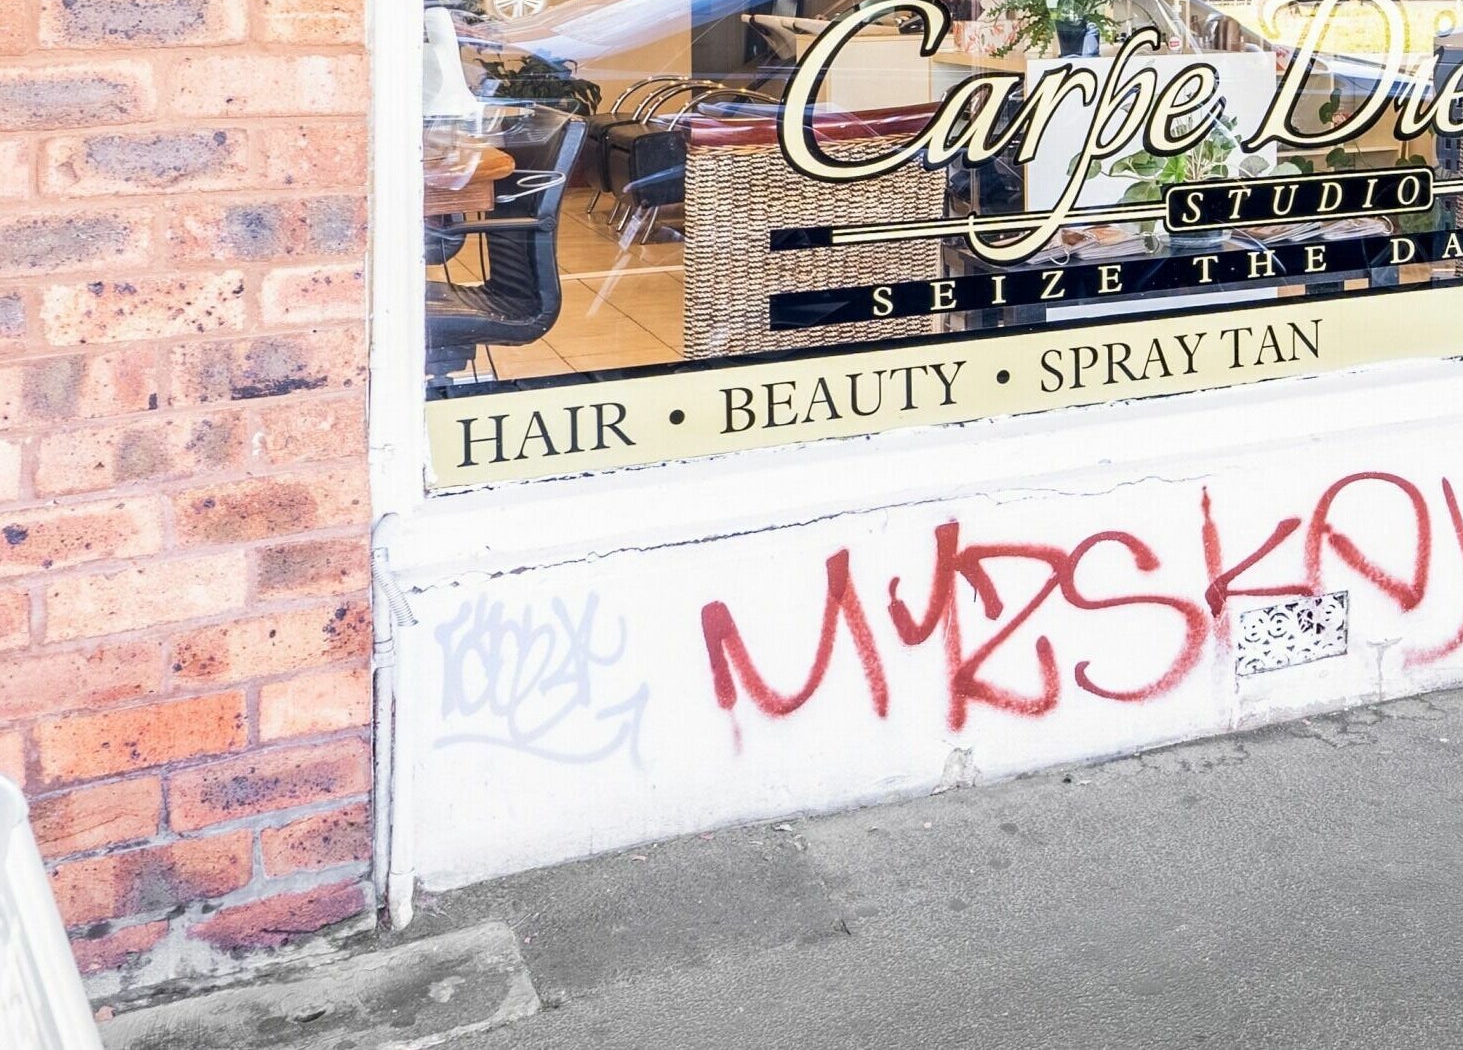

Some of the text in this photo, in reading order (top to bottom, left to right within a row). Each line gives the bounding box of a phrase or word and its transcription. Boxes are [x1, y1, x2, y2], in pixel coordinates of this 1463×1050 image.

[1179, 174, 1421, 225] STUDIO
[872, 264, 1123, 318] SEIZE
[1194, 244, 1326, 283] THE
[456, 318, 1323, 469] HAIR BEAUTY SPRAY TAN
